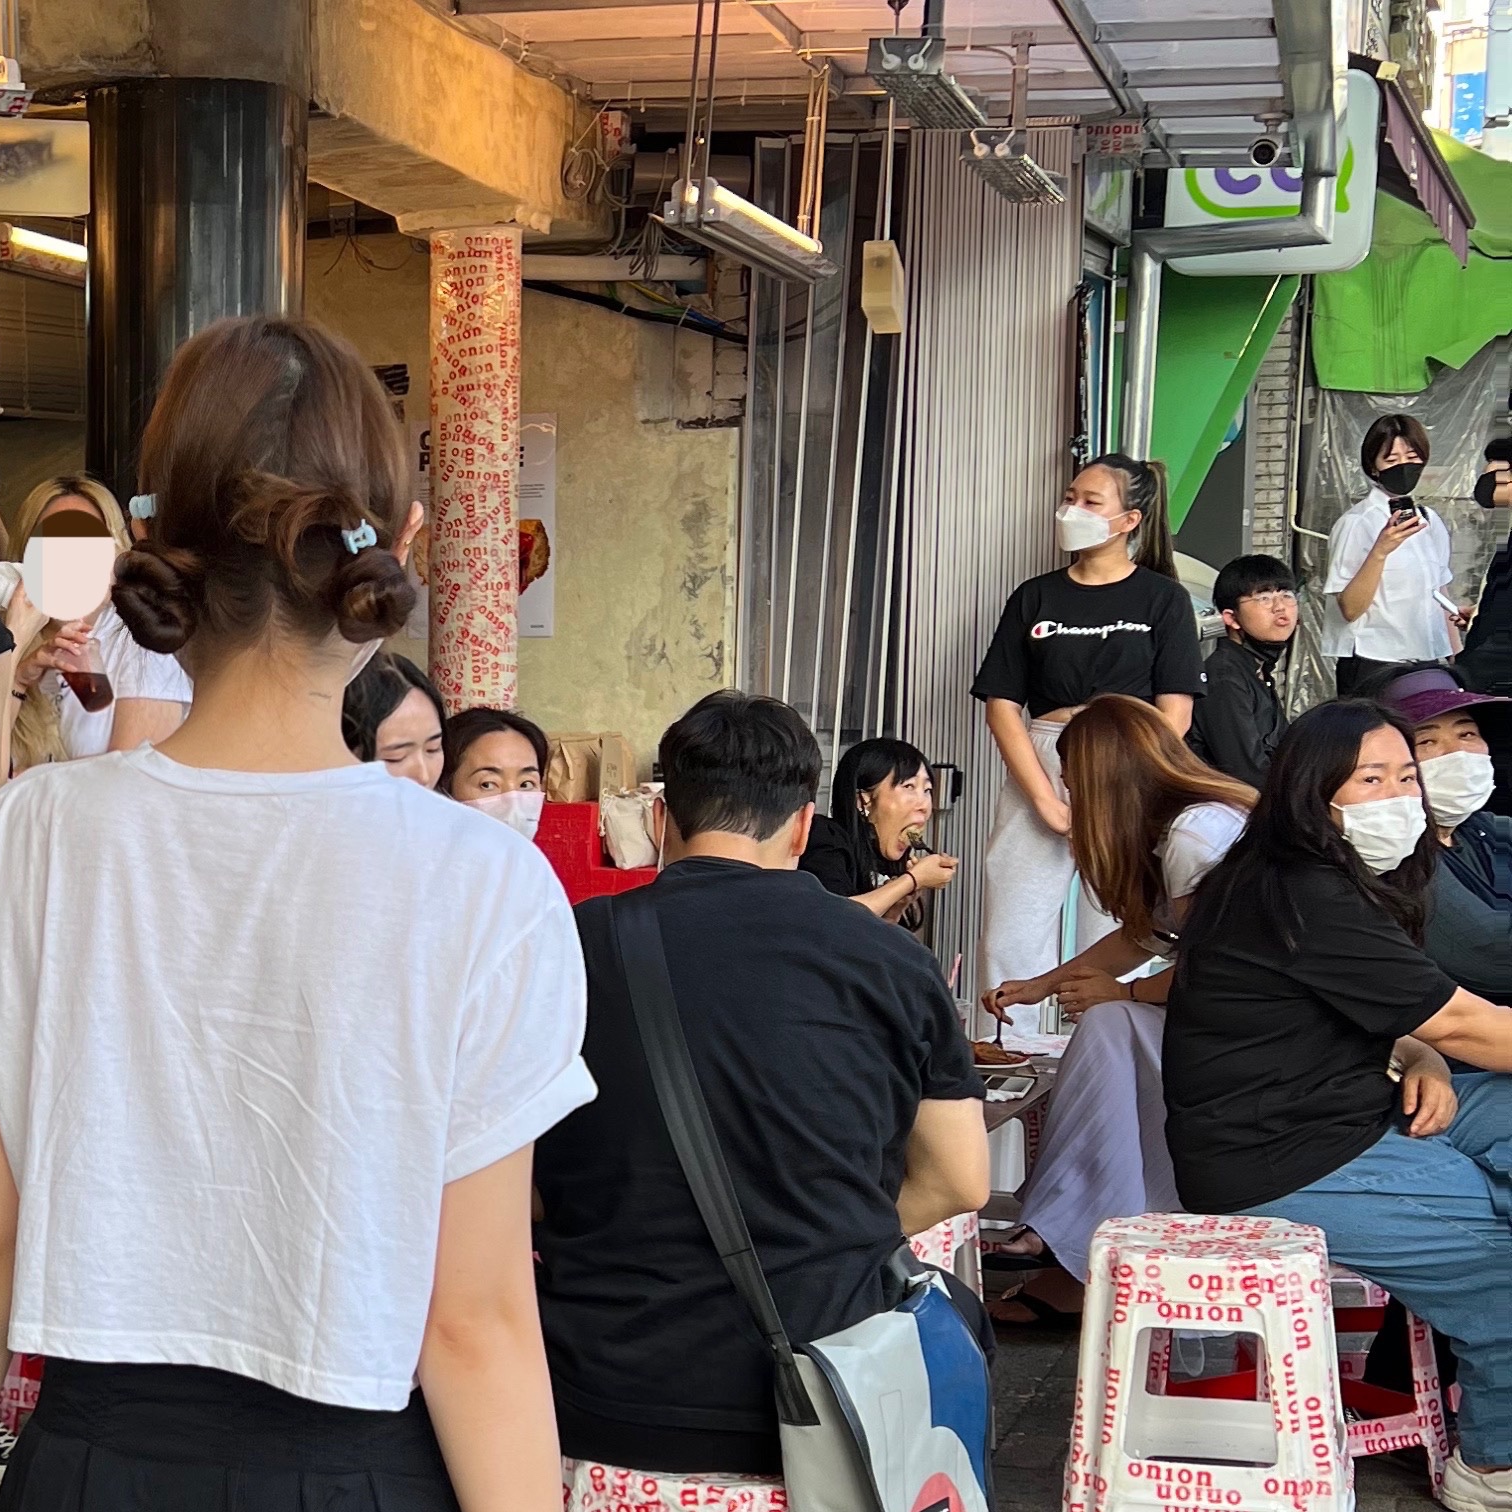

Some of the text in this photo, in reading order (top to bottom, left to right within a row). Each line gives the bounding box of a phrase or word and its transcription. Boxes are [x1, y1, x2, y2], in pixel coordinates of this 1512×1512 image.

[457, 470, 500, 483] onion
[1031, 620, 1151, 640] Champion
[1157, 1301, 1243, 1323] onion
[1288, 1271, 1312, 1351] onion
[1101, 1368, 1120, 1444] onion
[1127, 1461, 1212, 1487] onion
[1156, 1483, 1242, 1505] onion
